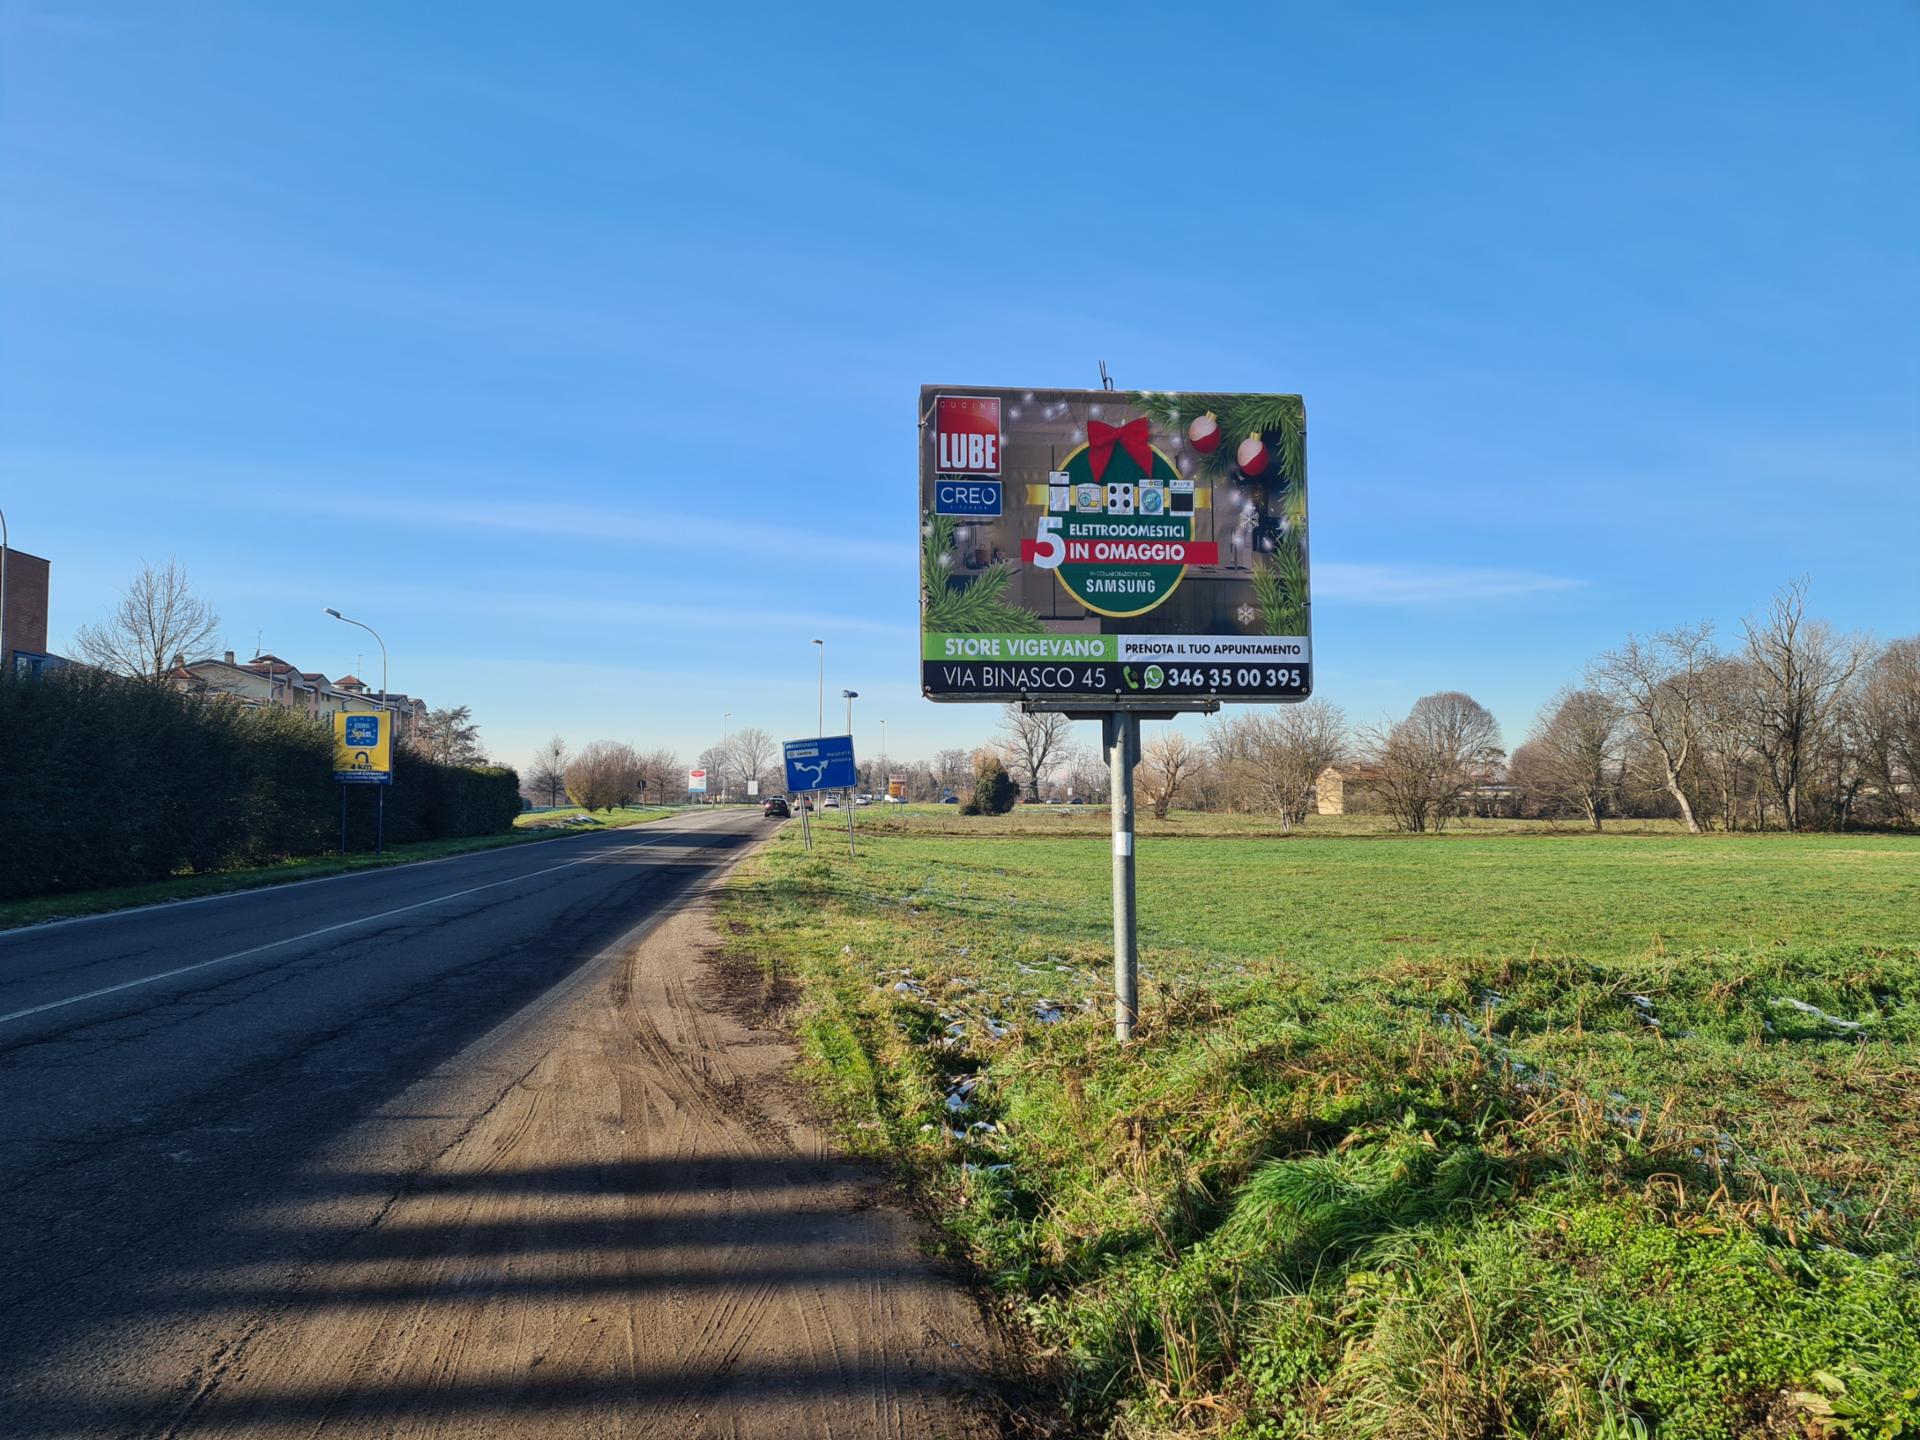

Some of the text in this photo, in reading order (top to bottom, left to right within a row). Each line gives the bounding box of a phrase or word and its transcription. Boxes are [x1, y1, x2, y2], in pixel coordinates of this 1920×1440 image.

[940, 401, 997, 410] CUCINE
[940, 432, 996, 469] LUBE
[941, 487, 996, 505] CREO
[1069, 523, 1185, 538] ELETTRODOMESTICI
[1033, 516, 1066, 569] 5
[1070, 542, 1185, 560] IN OMAGGIO
[1086, 579, 1155, 593] SAMSUNG
[945, 638, 1105, 657] STORE VIGEVANO
[1125, 643, 1301, 655] PRENOTA IL TUO APPUNTAMENTO
[943, 666, 1106, 688] VIA BINASCO 45
[1168, 668, 1301, 687] 346 35 00 395
[351, 729, 372, 739] Spin
